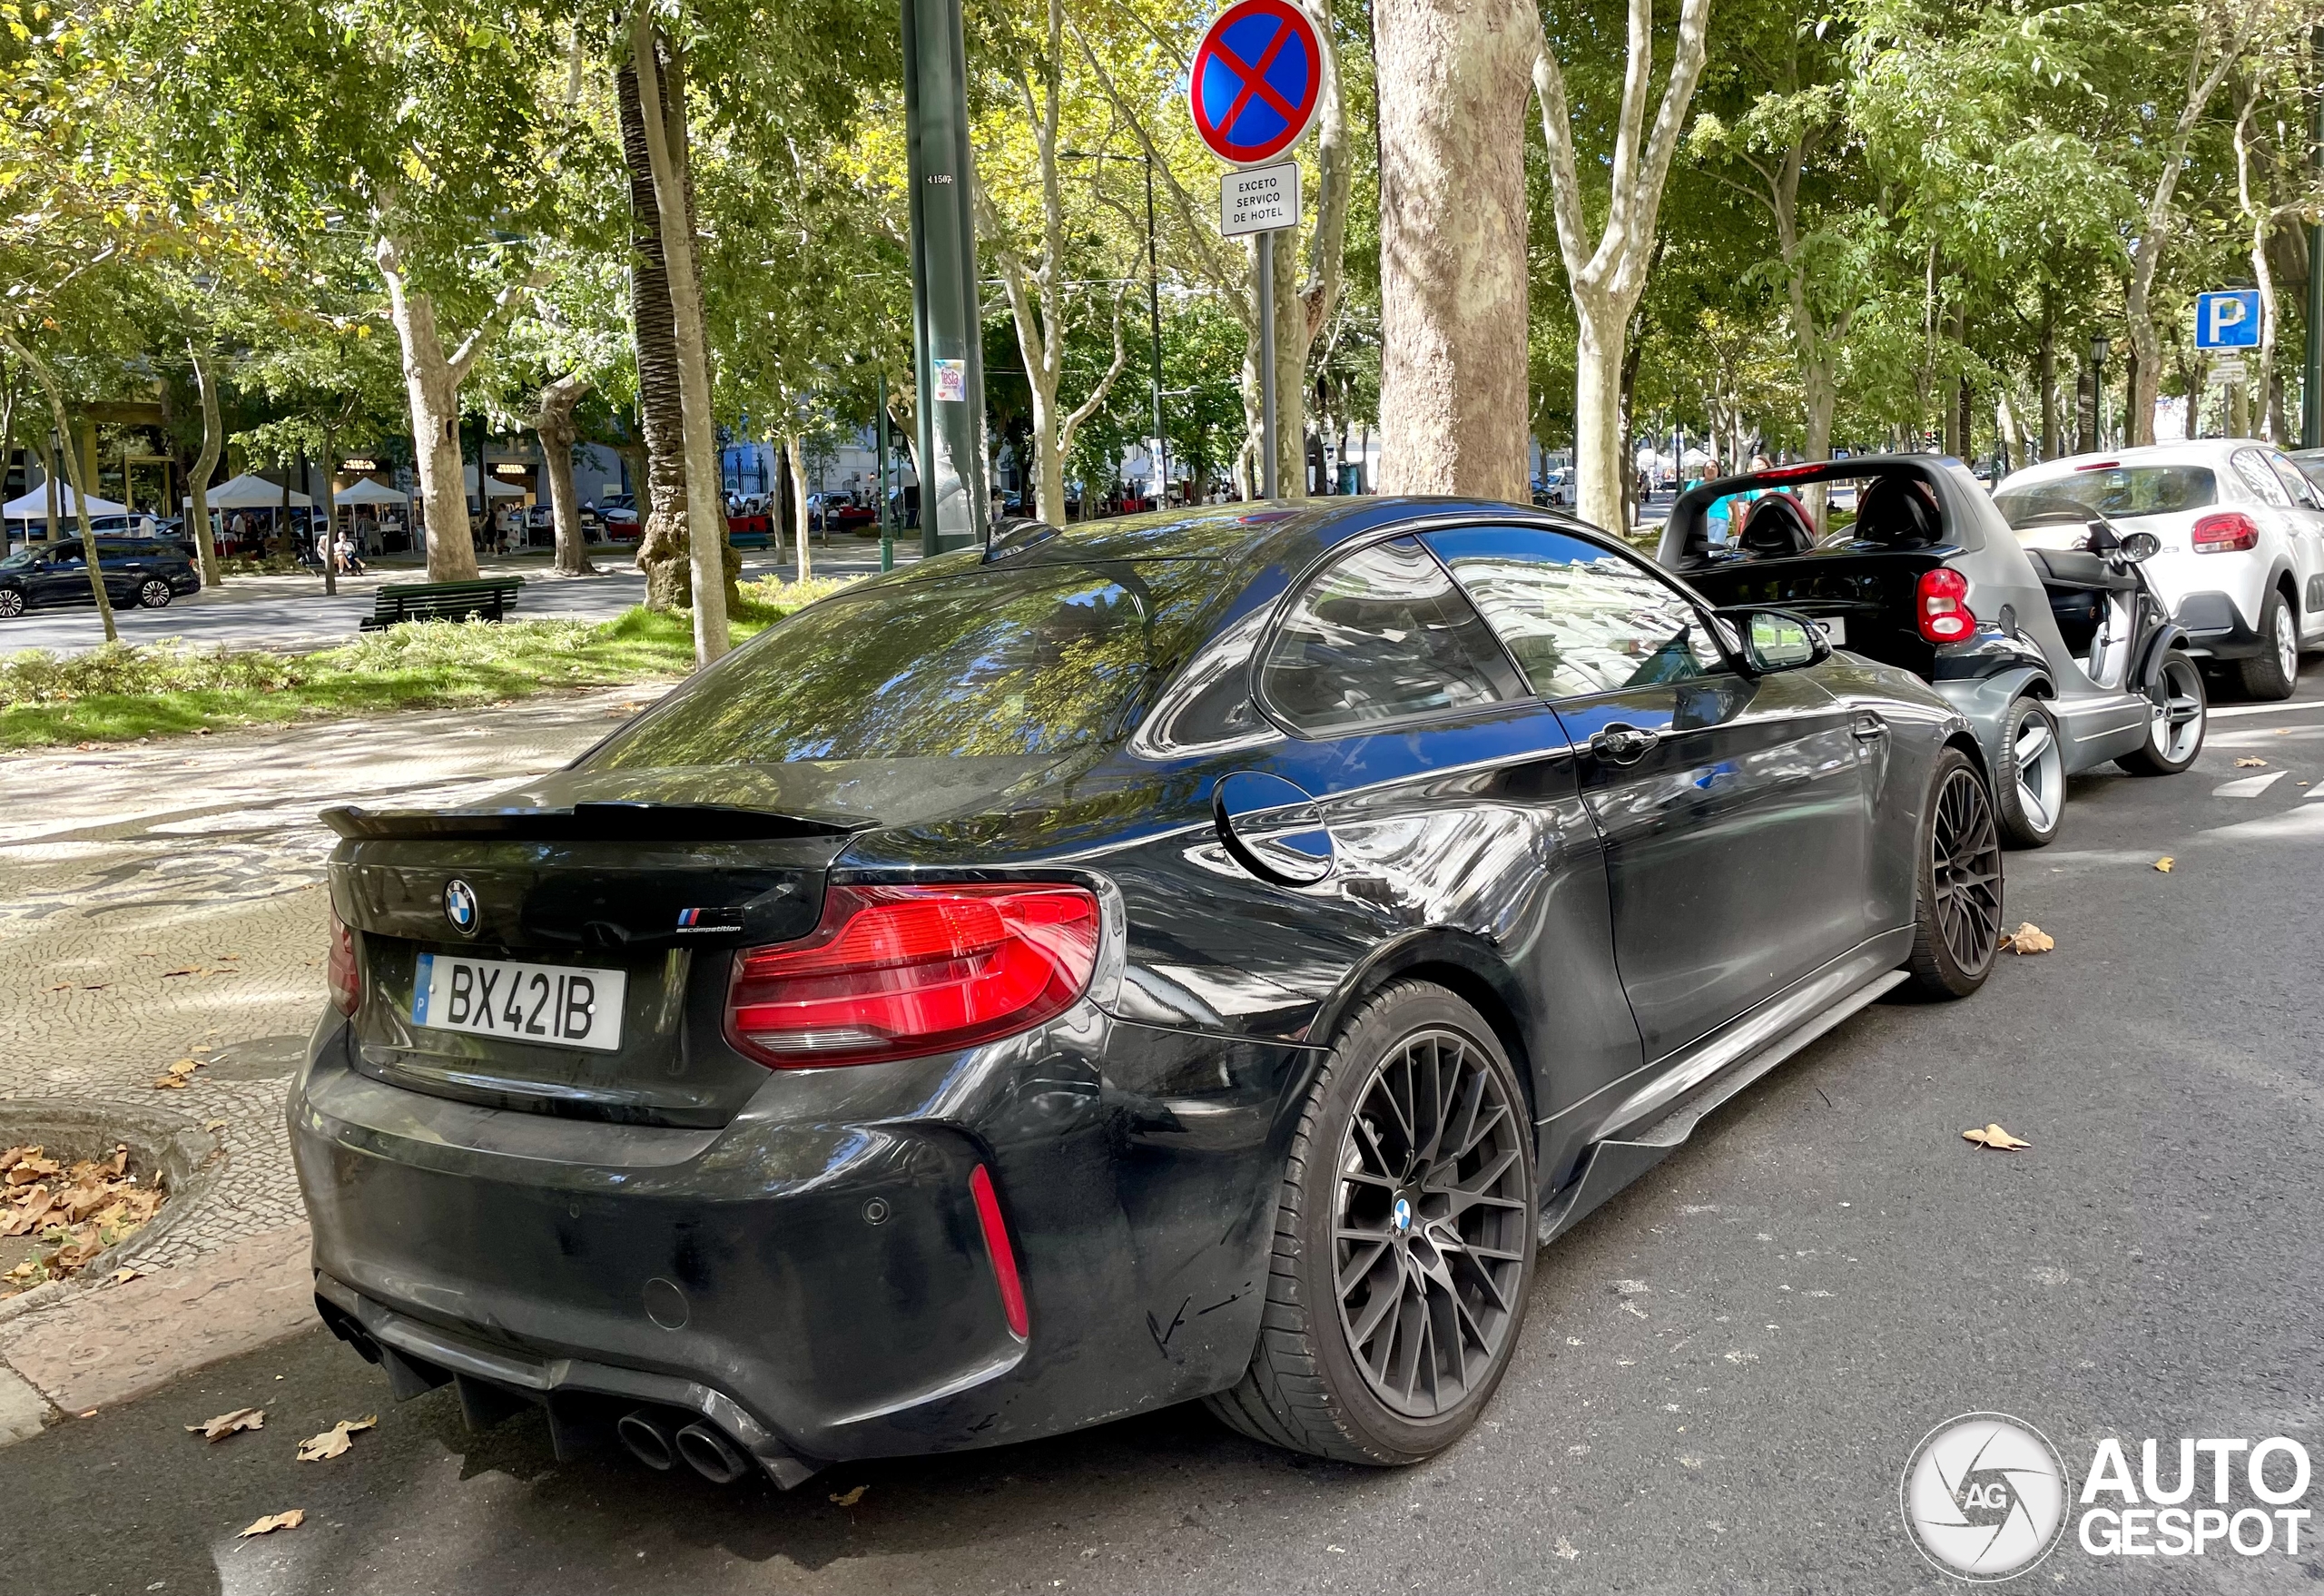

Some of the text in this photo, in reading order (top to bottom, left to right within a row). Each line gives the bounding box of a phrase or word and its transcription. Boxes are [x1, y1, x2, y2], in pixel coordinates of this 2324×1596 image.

[1238, 177, 1277, 192] EXCETO
[1236, 192, 1280, 208] SERVIÇO
[1234, 207, 1283, 223] DE HOTEL
[2209, 297, 2246, 343] P
[687, 925, 742, 933] competition
[417, 997, 425, 1012] P
